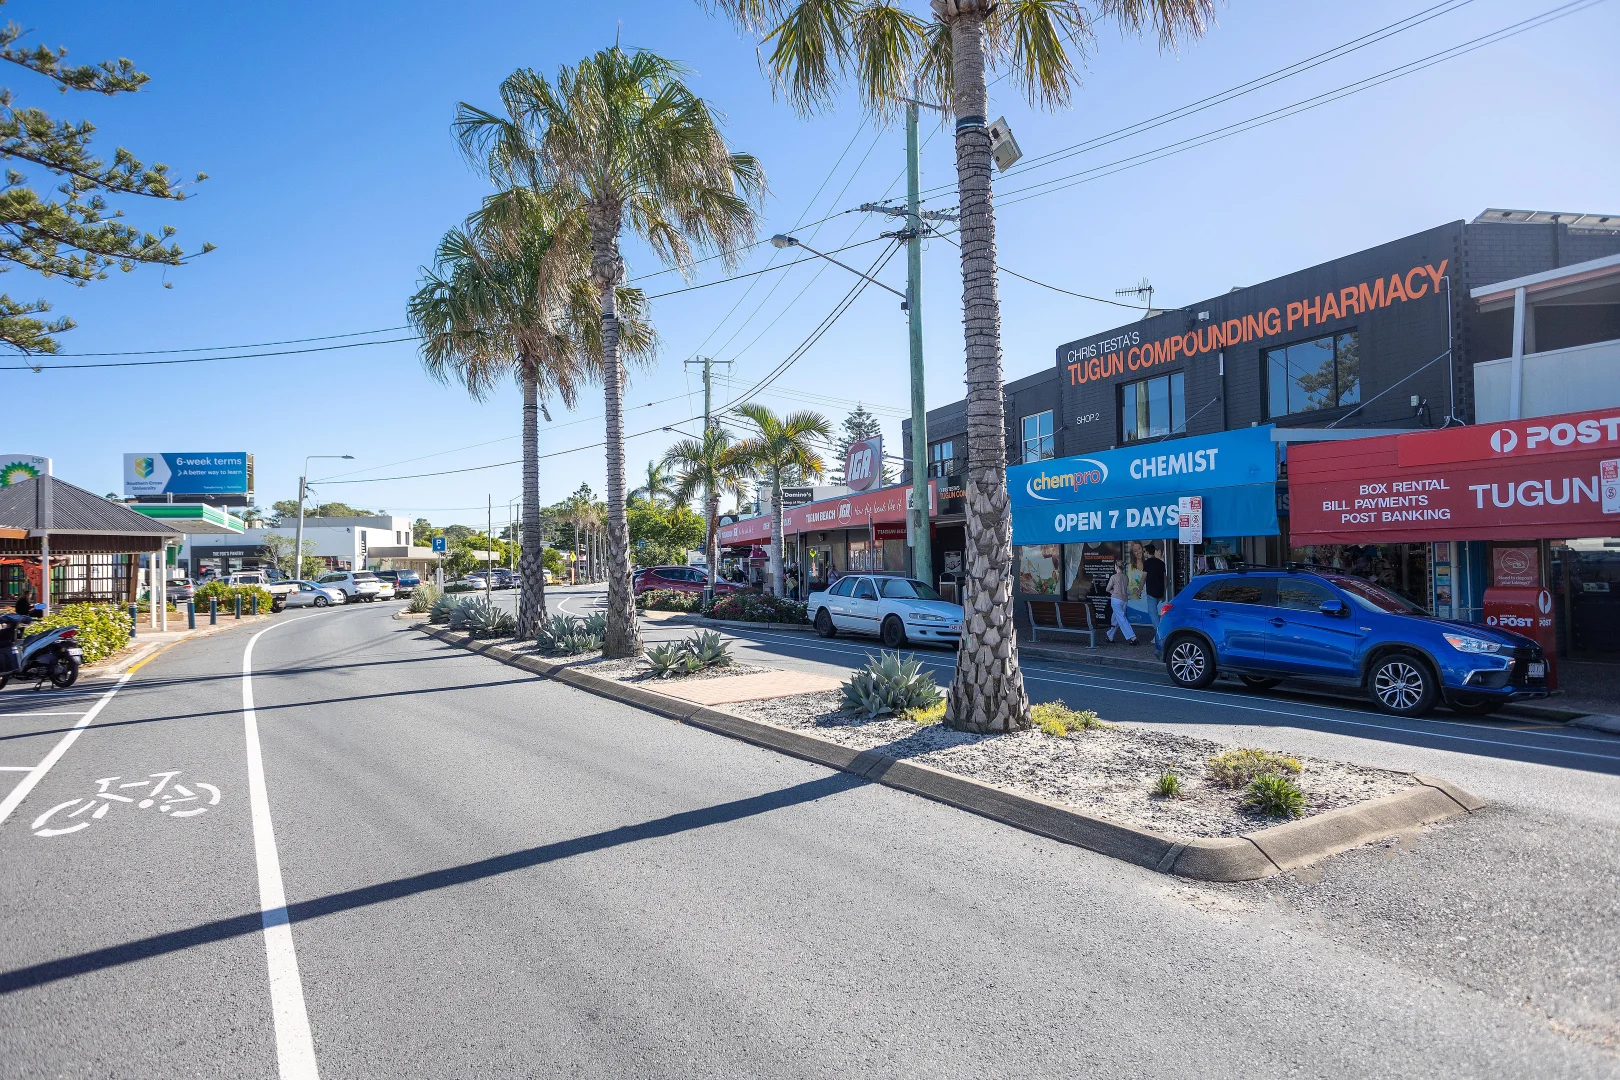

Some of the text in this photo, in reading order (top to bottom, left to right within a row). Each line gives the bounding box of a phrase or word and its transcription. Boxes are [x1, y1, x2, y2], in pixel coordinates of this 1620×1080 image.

[1067, 259, 1449, 386] TUGUN COMPOUNDING PHARMACY
[1067, 331, 1140, 363] CHRIS TESTA'S
[1076, 412, 1100, 425] SHOP 2
[1526, 416, 1620, 449] POST
[32, 457, 44, 465] bp
[176, 457, 242, 466] 6-week terms
[847, 449, 872, 482] IGA
[1129, 448, 1219, 480] CHEMIST
[1033, 469, 1101, 492] chempro
[1359, 479, 1450, 495] BOX RENTAL
[1468, 476, 1599, 509] TUGUN
[819, 509, 836, 521] BEACH
[839, 503, 851, 518] IGA
[1322, 495, 1429, 511] BILL PAYMENTS
[1054, 510, 1102, 533] OPEN
[1108, 509, 1120, 529] 7
[1126, 504, 1180, 528] DAYS
[1341, 508, 1451, 524] POST BANKING
[1499, 617, 1533, 627] POST
[1538, 618, 1552, 627] POST
